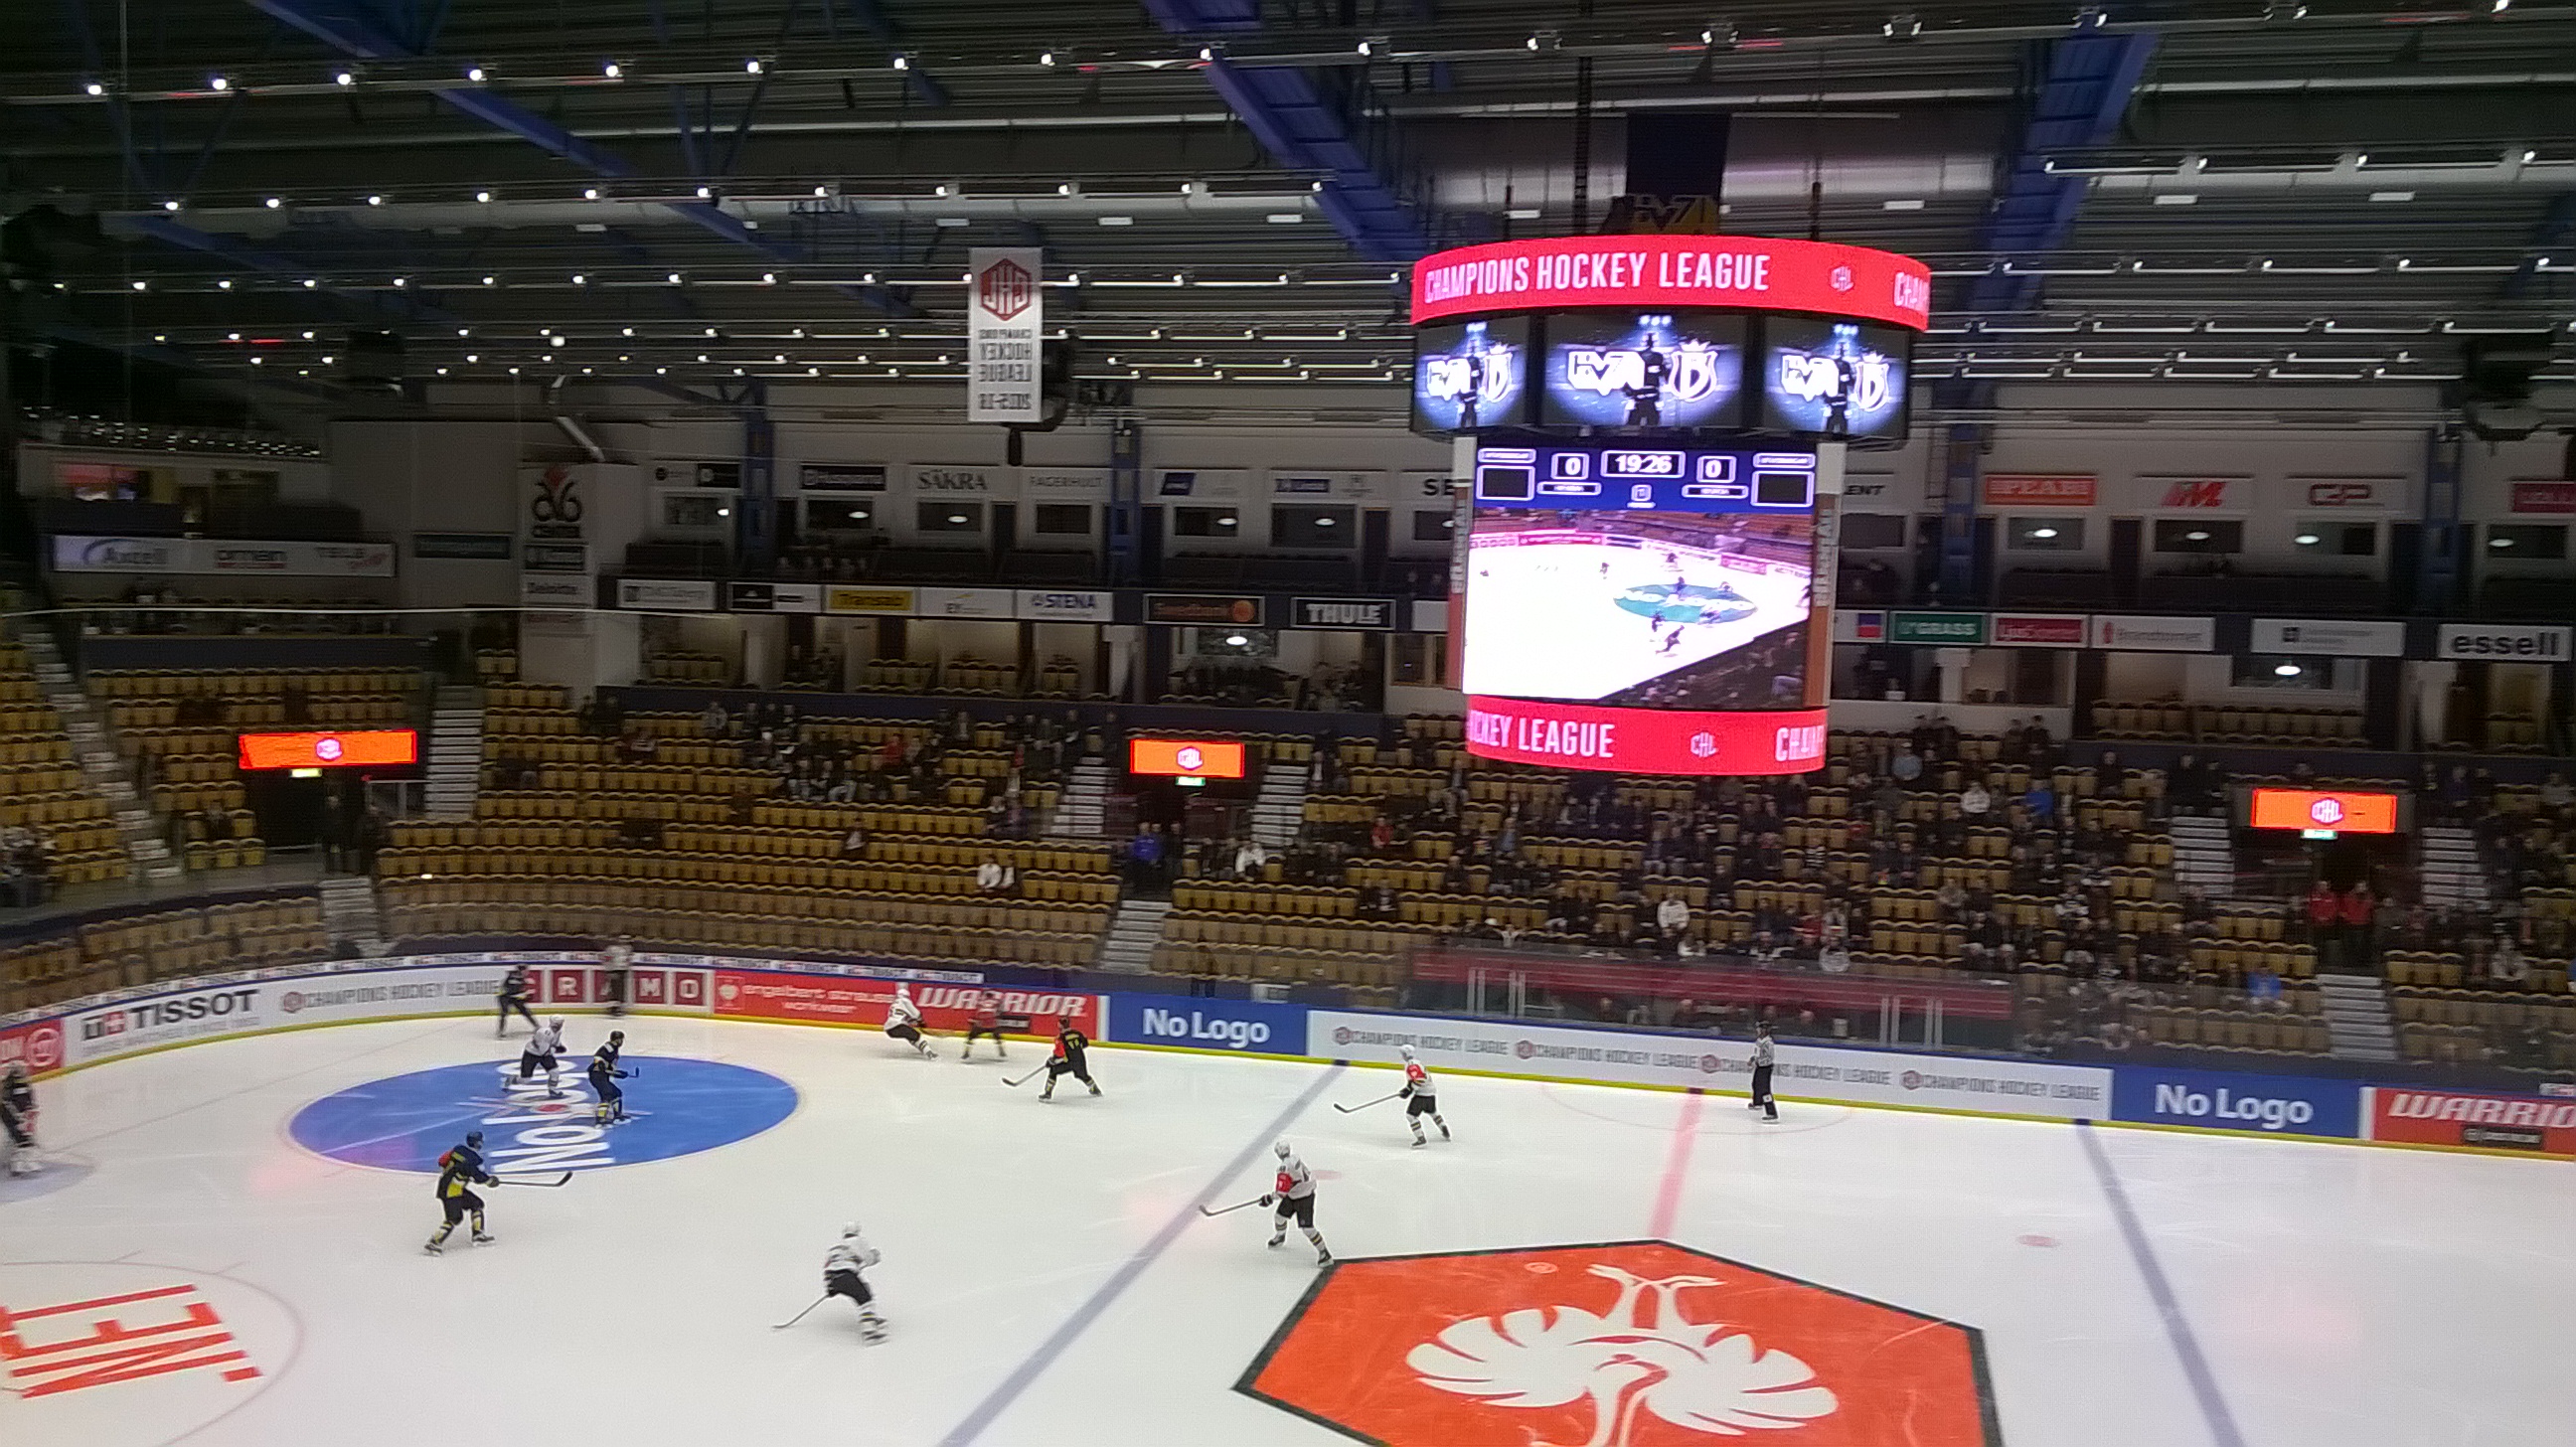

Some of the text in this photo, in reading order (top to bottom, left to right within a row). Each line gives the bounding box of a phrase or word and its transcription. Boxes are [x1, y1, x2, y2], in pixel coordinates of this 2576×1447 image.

[1425, 252, 1771, 303] CHAMPIONS HOCKEY LEAGUE
[1565, 457, 1581, 475] 0
[1705, 460, 1721, 478] 0
[1306, 602, 1382, 625] THULE
[1519, 718, 1616, 758] LEAGUE
[129, 989, 259, 1030] TISSOT
[1143, 1008, 1270, 1048] No Logo
[2155, 1083, 2315, 1129] No Logo
